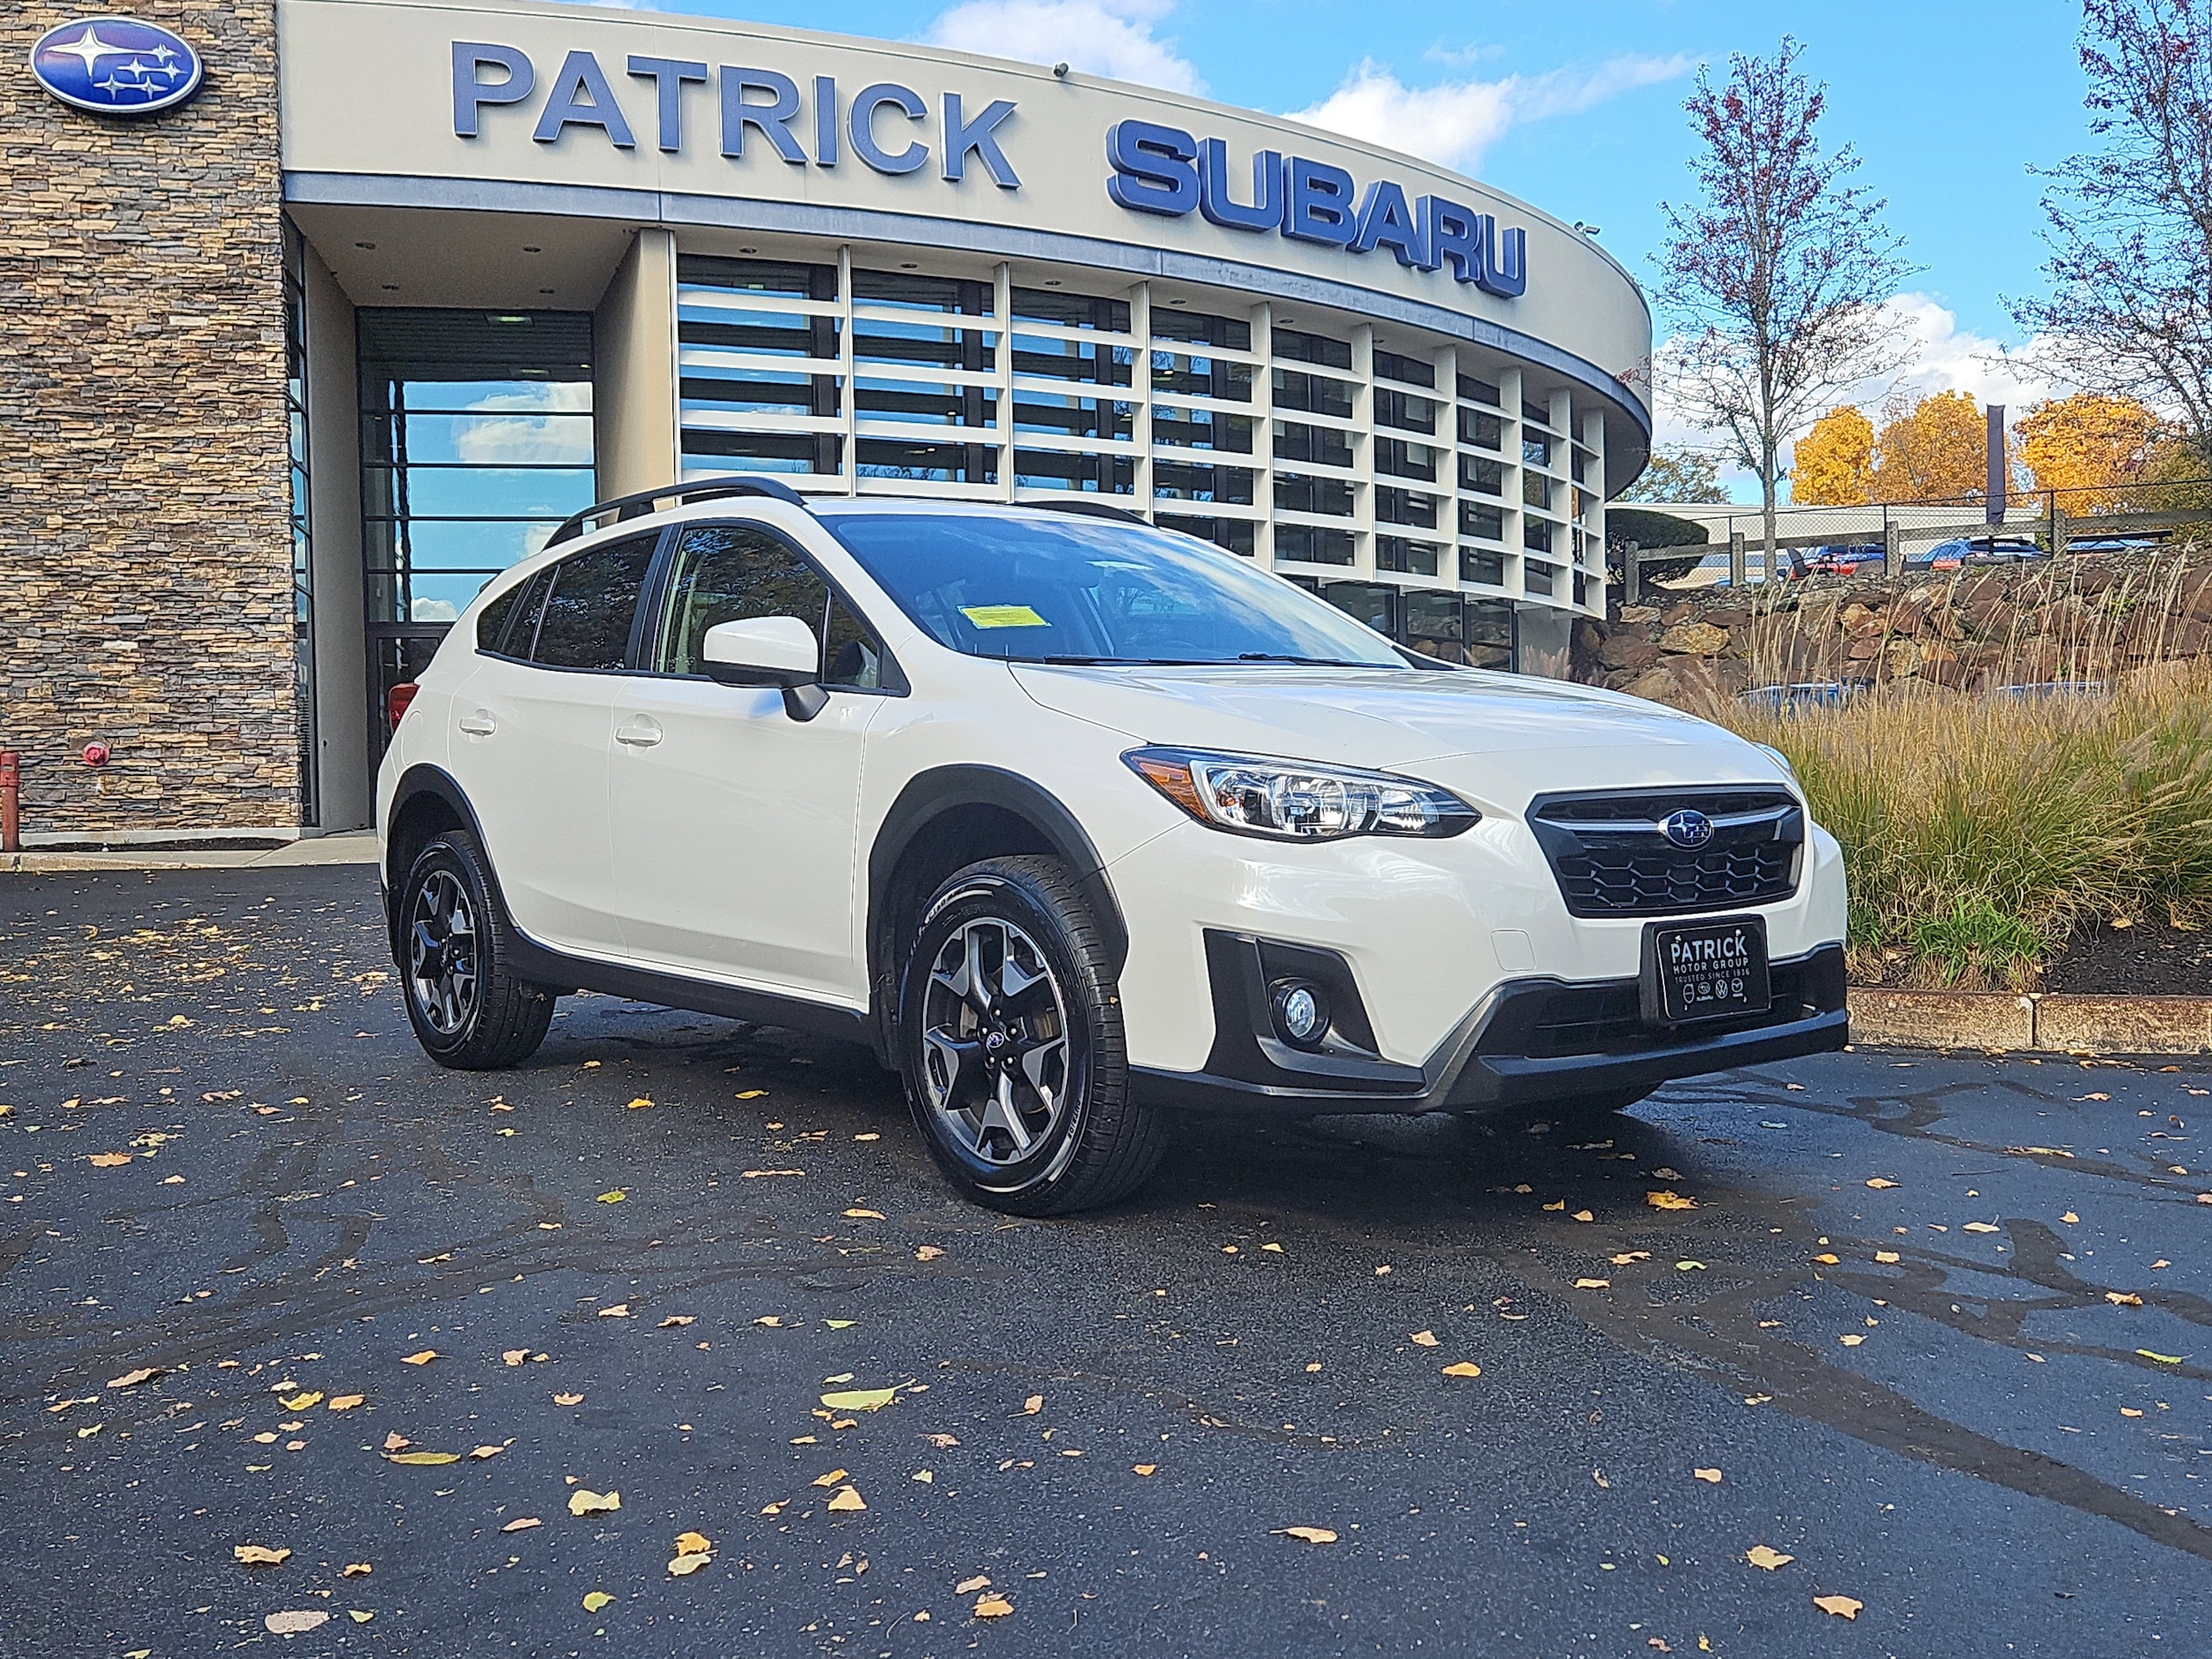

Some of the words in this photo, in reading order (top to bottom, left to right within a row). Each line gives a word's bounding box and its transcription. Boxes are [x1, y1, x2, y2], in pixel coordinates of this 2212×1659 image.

[451, 40, 1022, 189] PATRICK
[1106, 119, 1526, 298] SUBARU
[1671, 936, 1747, 964] PATRICK
[1674, 964, 1707, 974] MOTOR
[1713, 957, 1748, 970] GROUP
[1675, 973, 1705, 985] TRUSTED
[1708, 971, 1730, 980] SINCE
